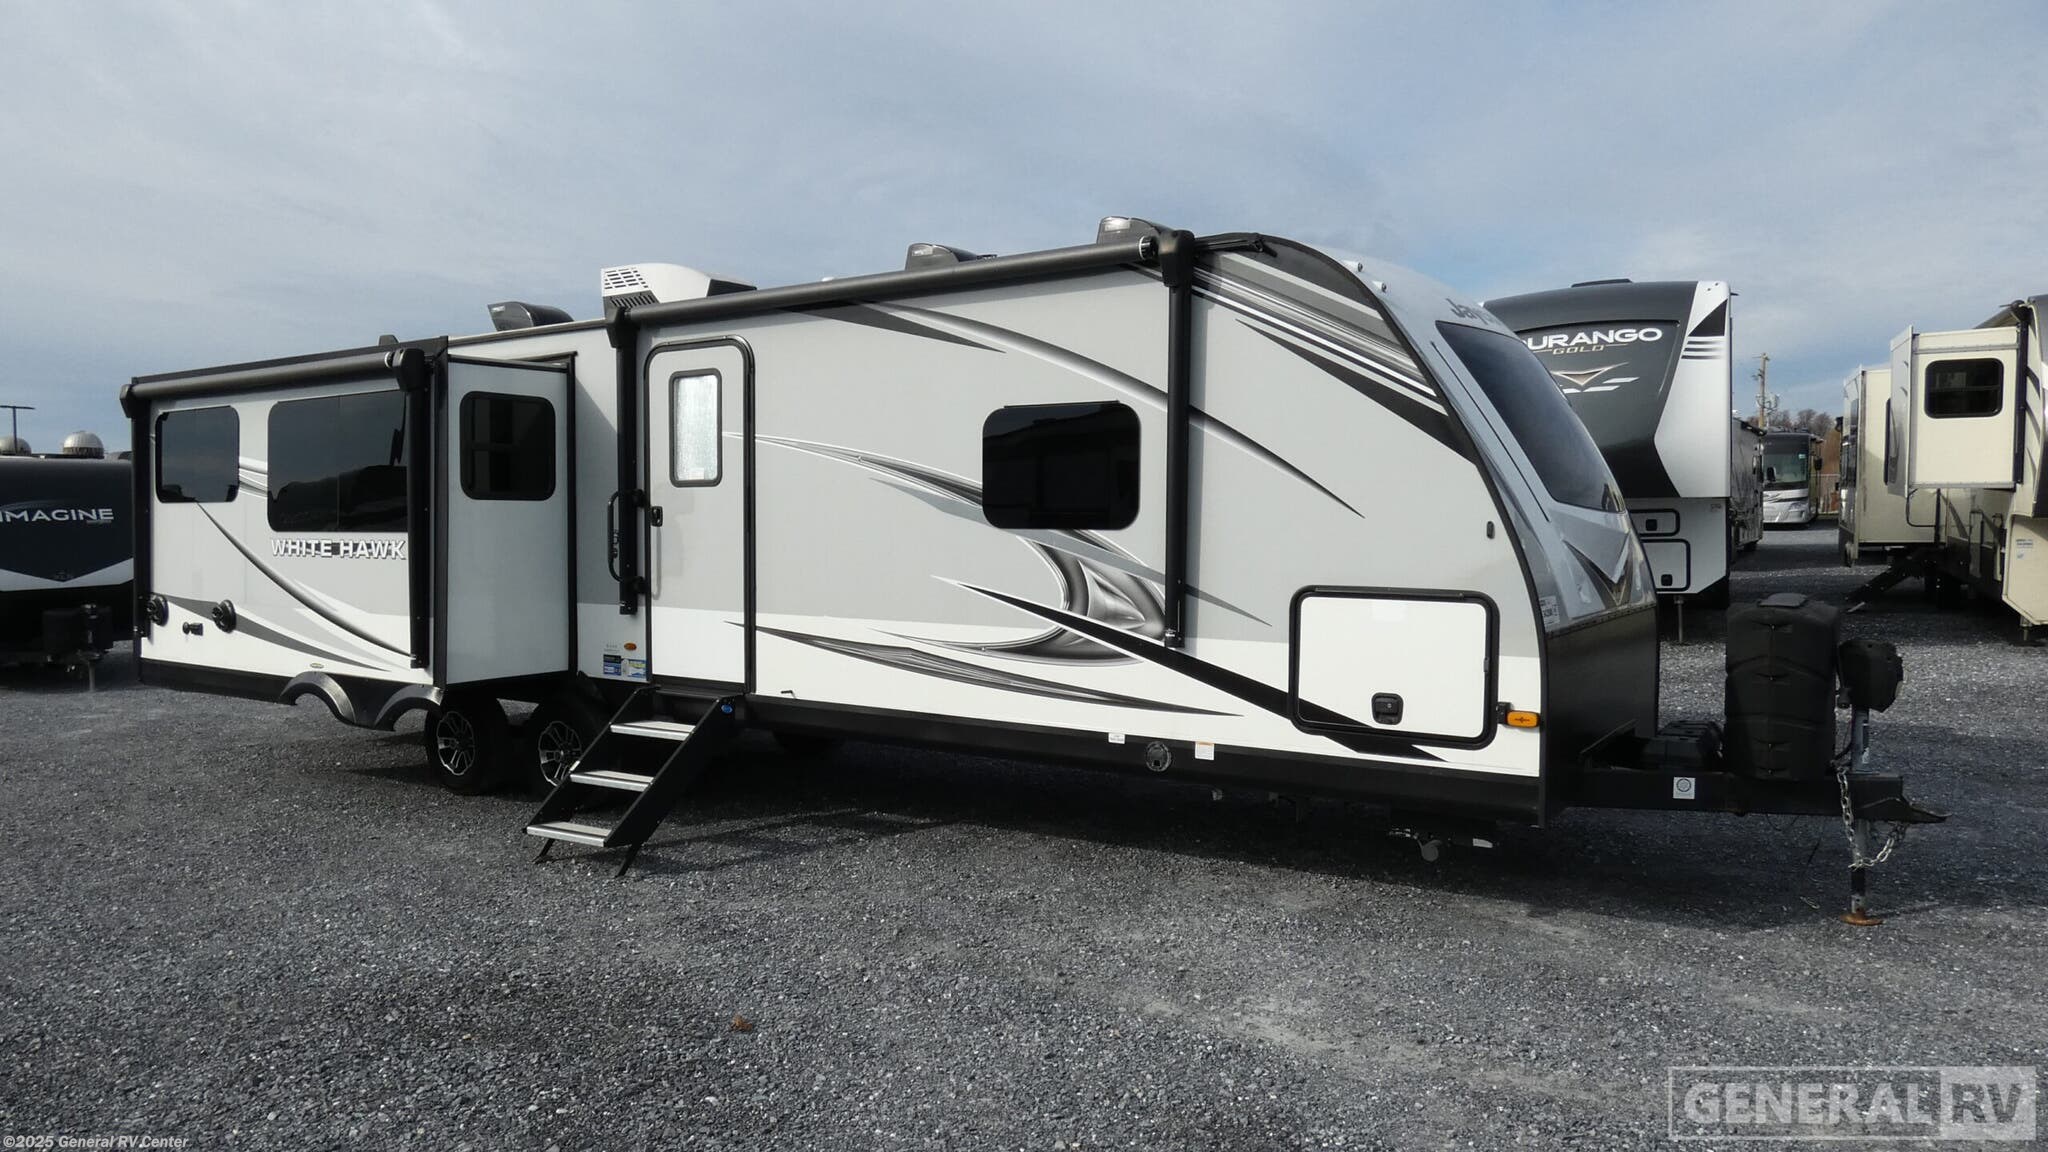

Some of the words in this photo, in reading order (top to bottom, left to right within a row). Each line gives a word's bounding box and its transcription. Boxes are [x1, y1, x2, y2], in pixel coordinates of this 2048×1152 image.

[1522, 327, 1663, 350] URANGO
[1552, 344, 1605, 355] GOLD
[271, 539, 333, 558] WHITE
[339, 539, 406, 560] HAWK
